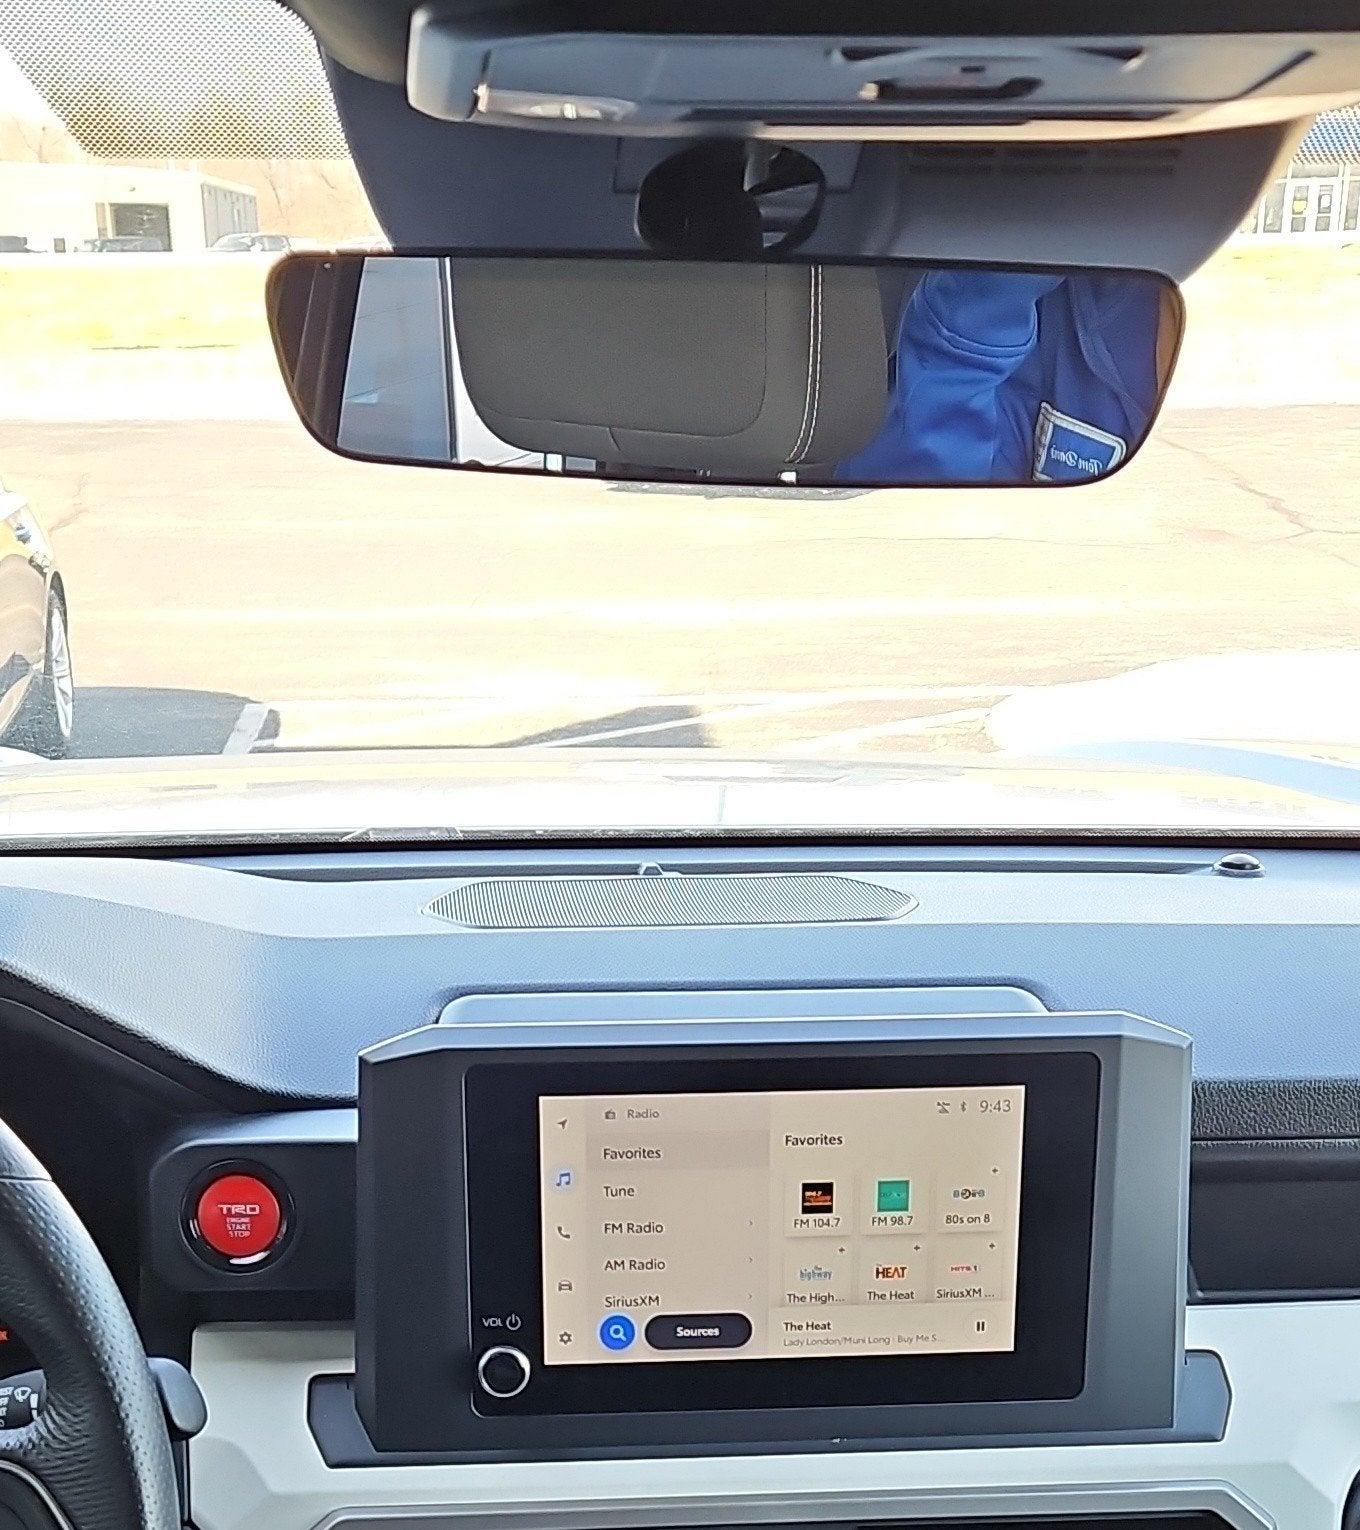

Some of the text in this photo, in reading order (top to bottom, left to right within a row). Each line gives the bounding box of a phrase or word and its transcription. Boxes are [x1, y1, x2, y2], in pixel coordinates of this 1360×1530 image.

[979, 1099, 1012, 1113] 9:43
[627, 1108, 660, 1119] Radio
[785, 1133, 843, 1147] Favorites
[603, 1147, 662, 1160] Favorites
[603, 1185, 636, 1198] Tune
[217, 1204, 260, 1215] TRD
[793, 1217, 841, 1229] FM 104.7
[871, 1215, 914, 1227] FM 98.7
[945, 1213, 991, 1225] 80s on 8
[603, 1222, 665, 1235] FM Radio
[604, 1259, 667, 1272] AM Radio
[875, 1266, 908, 1280] HEAT
[786, 1293, 807, 1303] The
[867, 1290, 915, 1301] The Heat
[936, 1287, 982, 1299] SiriusXM
[604, 1294, 661, 1309] SiriusXM
[482, 1316, 505, 1327] VOL
[783, 1320, 832, 1332] The Heat
[676, 1325, 720, 1338] Sources
[783, 1337, 804, 1348] Lady
[868, 1335, 891, 1346] Long
[897, 1335, 914, 1345] Buy
[915, 1334, 930, 1343] Me
